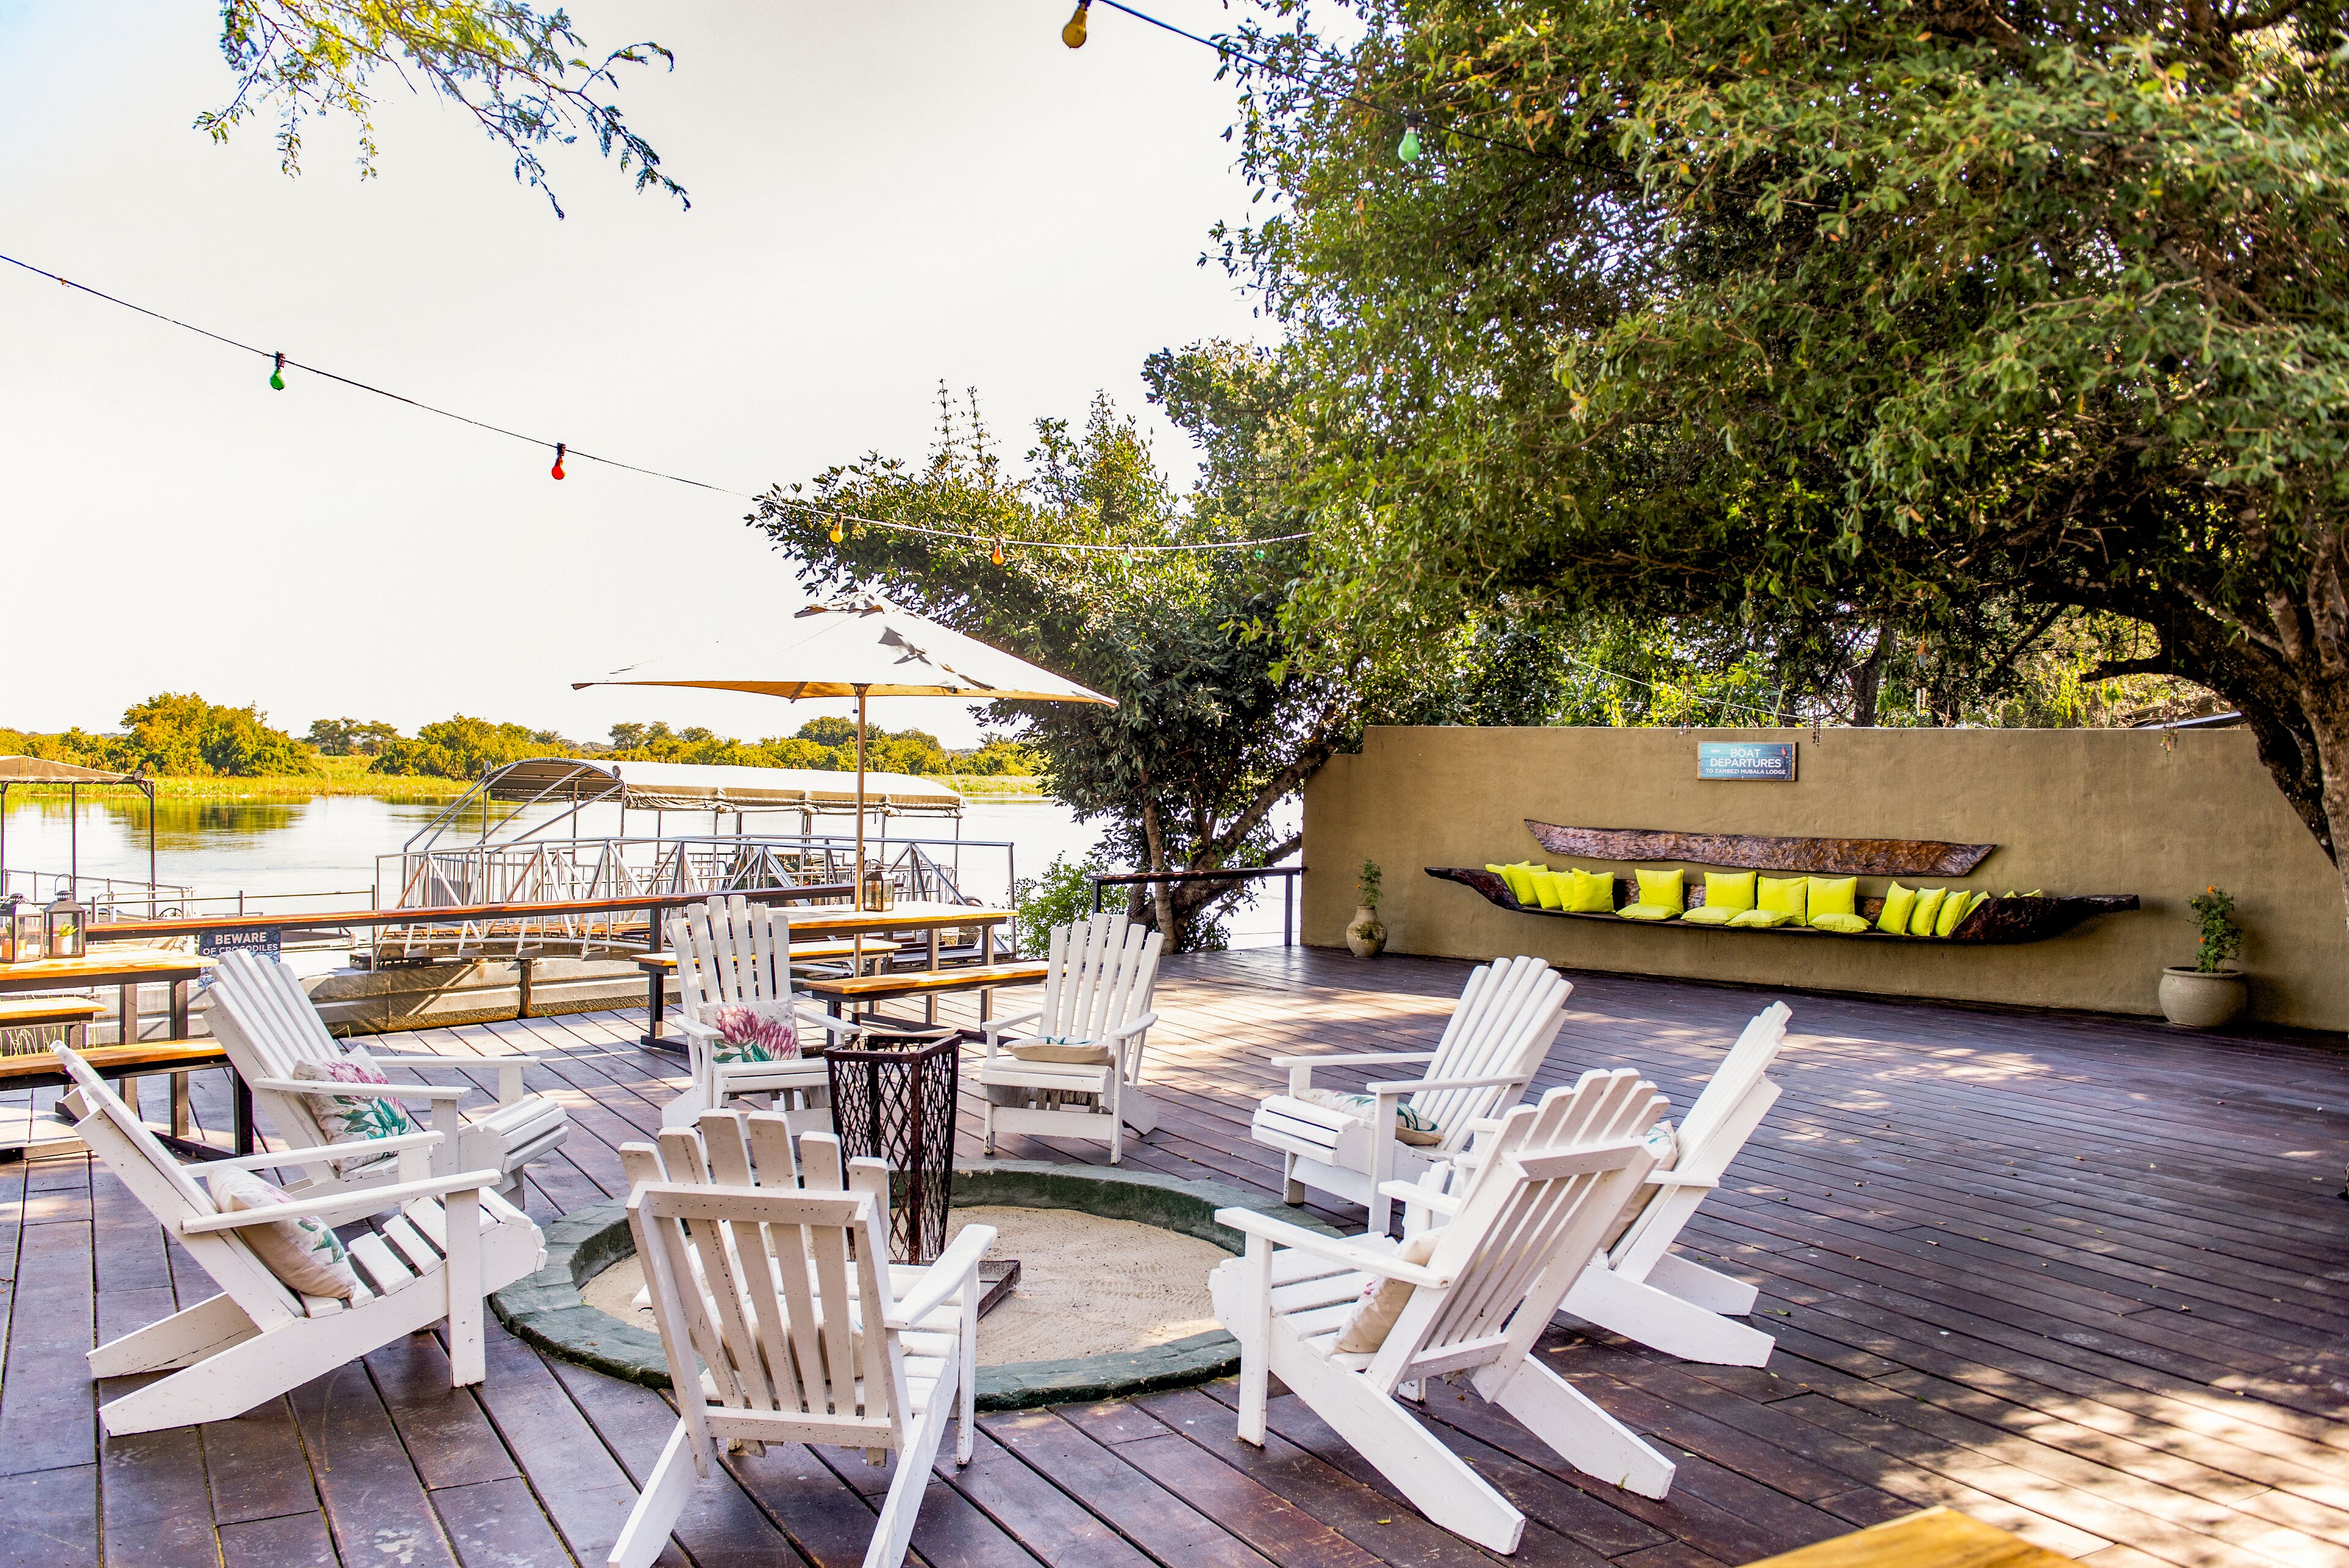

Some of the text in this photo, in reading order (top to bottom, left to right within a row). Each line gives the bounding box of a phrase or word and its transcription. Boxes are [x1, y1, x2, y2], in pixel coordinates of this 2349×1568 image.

[1731, 749, 1761, 757] BOAT
[1710, 759, 1781, 768] DEPARTURES
[215, 932, 267, 945] BEWARE
